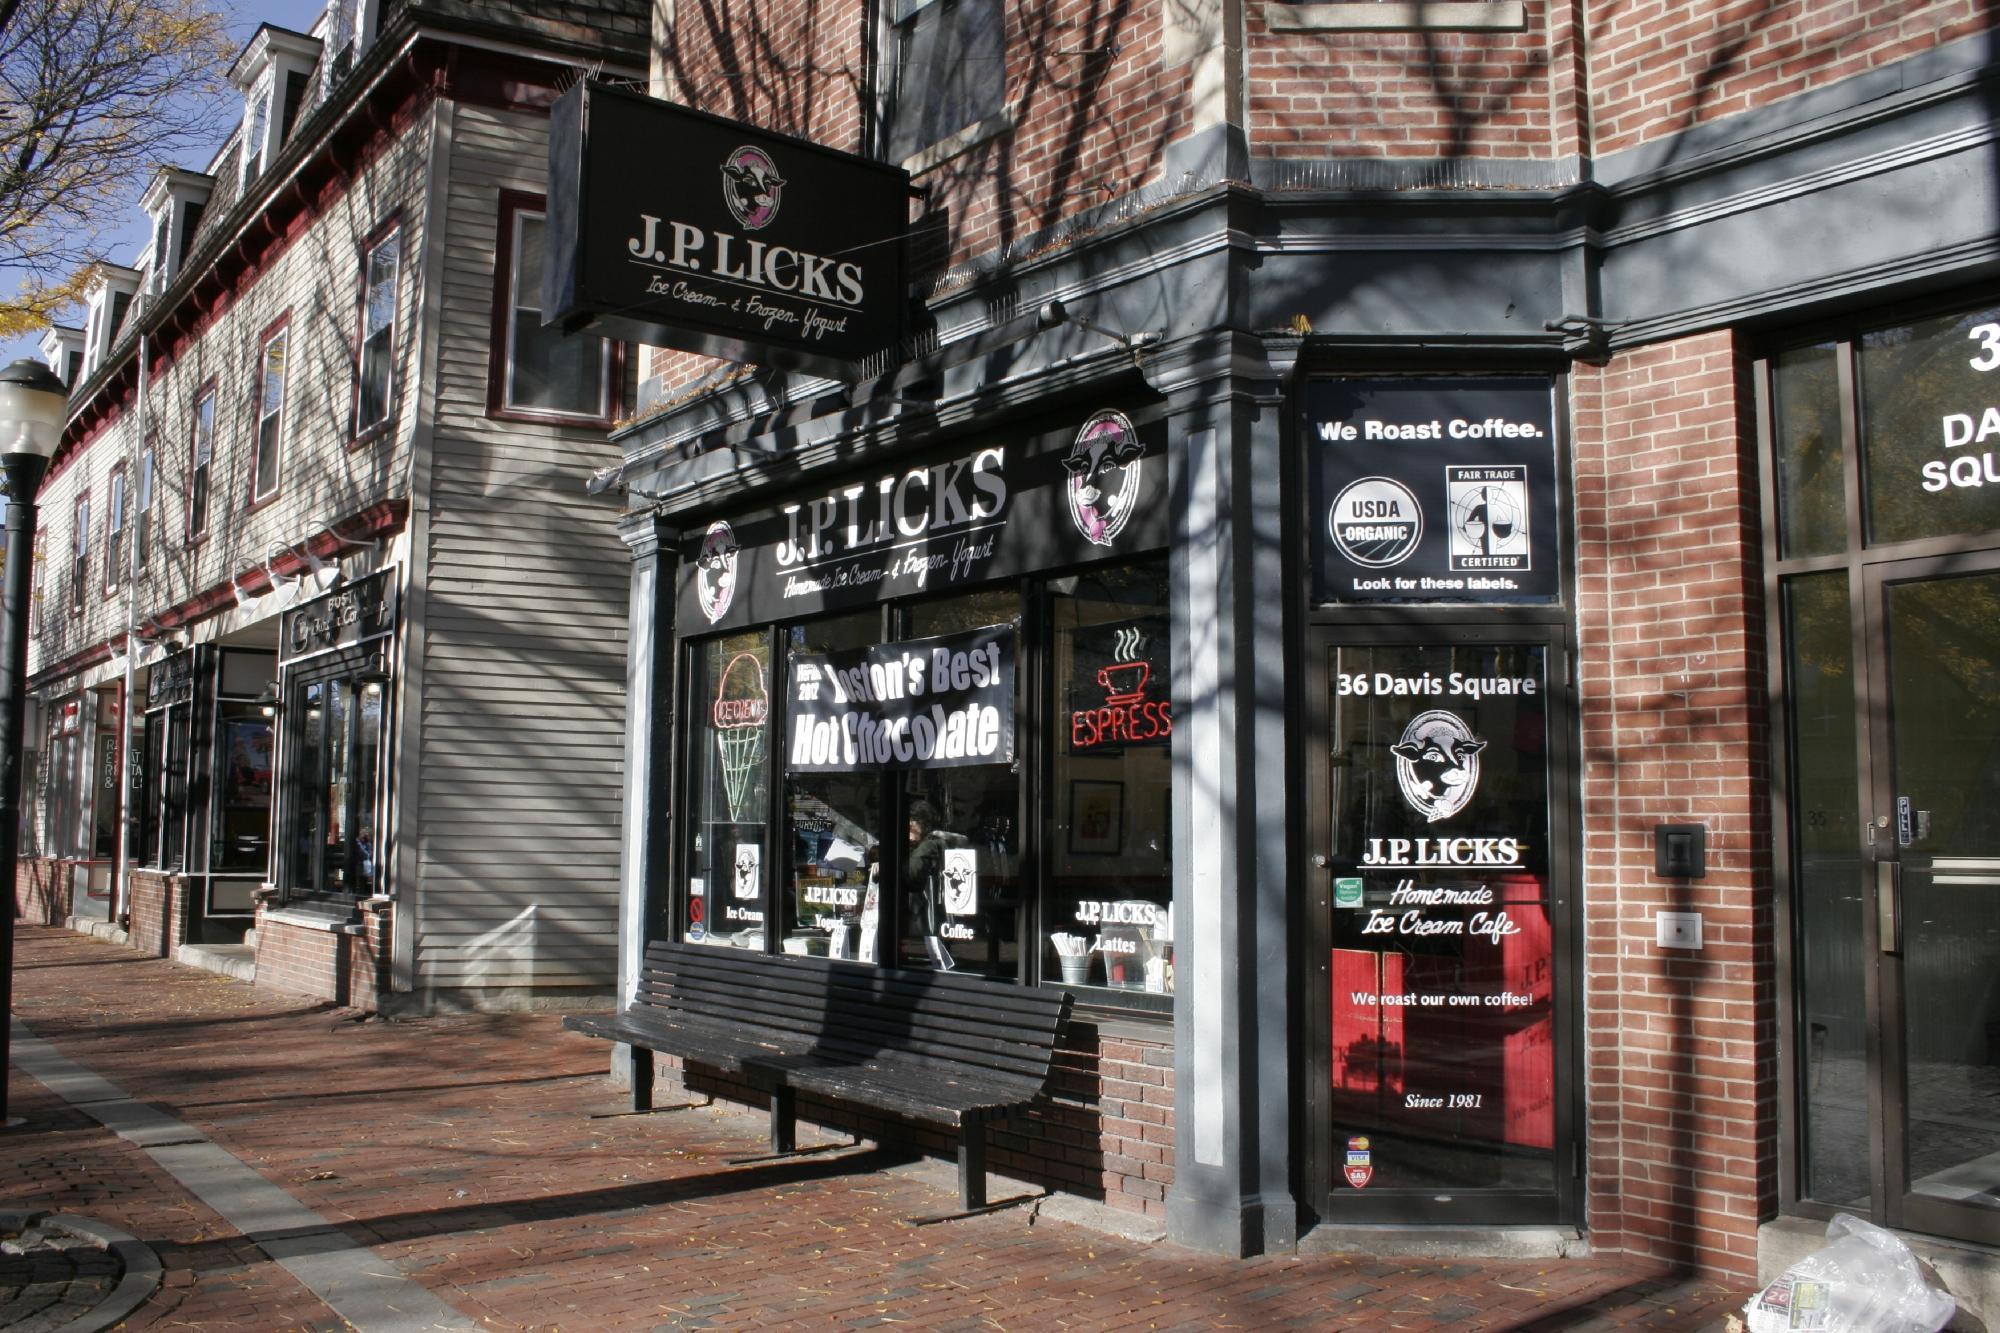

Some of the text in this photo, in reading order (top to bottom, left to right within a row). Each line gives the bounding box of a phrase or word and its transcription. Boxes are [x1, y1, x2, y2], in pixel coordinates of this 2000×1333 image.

[628, 213, 865, 305] J.P. LICKS
[646, 275, 848, 341] Ice Cream & Frozen Yogurt
[1317, 418, 1544, 441] We Roast Coffee.
[1942, 407, 2000, 448] DA
[1458, 469, 1516, 480] FAIR TRADE
[1921, 452, 2000, 492] SQU
[776, 447, 1007, 566] J.P. LICKS
[1351, 500, 1401, 518] USDA
[1345, 525, 1408, 541] ORGANIC
[783, 534, 994, 599] Homemade Ice Cream & Frozen Yogurt
[1460, 556, 1519, 568] CERTIFIED
[1353, 576, 1519, 590] Look for these labels.
[931, 641, 1002, 693] Best
[1337, 672, 1537, 701] 36 Davis Square
[791, 702, 1000, 765] Hot Chocolate
[1899, 799, 1909, 832] PULL
[1363, 837, 1519, 865] J.P. LICKS
[804, 886, 858, 906] J.P. LICKS
[1389, 879, 1494, 906] Homemade
[726, 906, 765, 922] Ice Cream
[815, 913, 844, 933] Yogurt
[1075, 901, 1156, 925] J.P. LICKS
[940, 922, 974, 940] Coffee
[1361, 909, 1522, 946] Ice Cream Cafe
[1096, 934, 1136, 953] Lattes
[1351, 992, 1534, 1006] We roast our own coffee!
[1404, 1093, 1483, 1108] Since 1981
